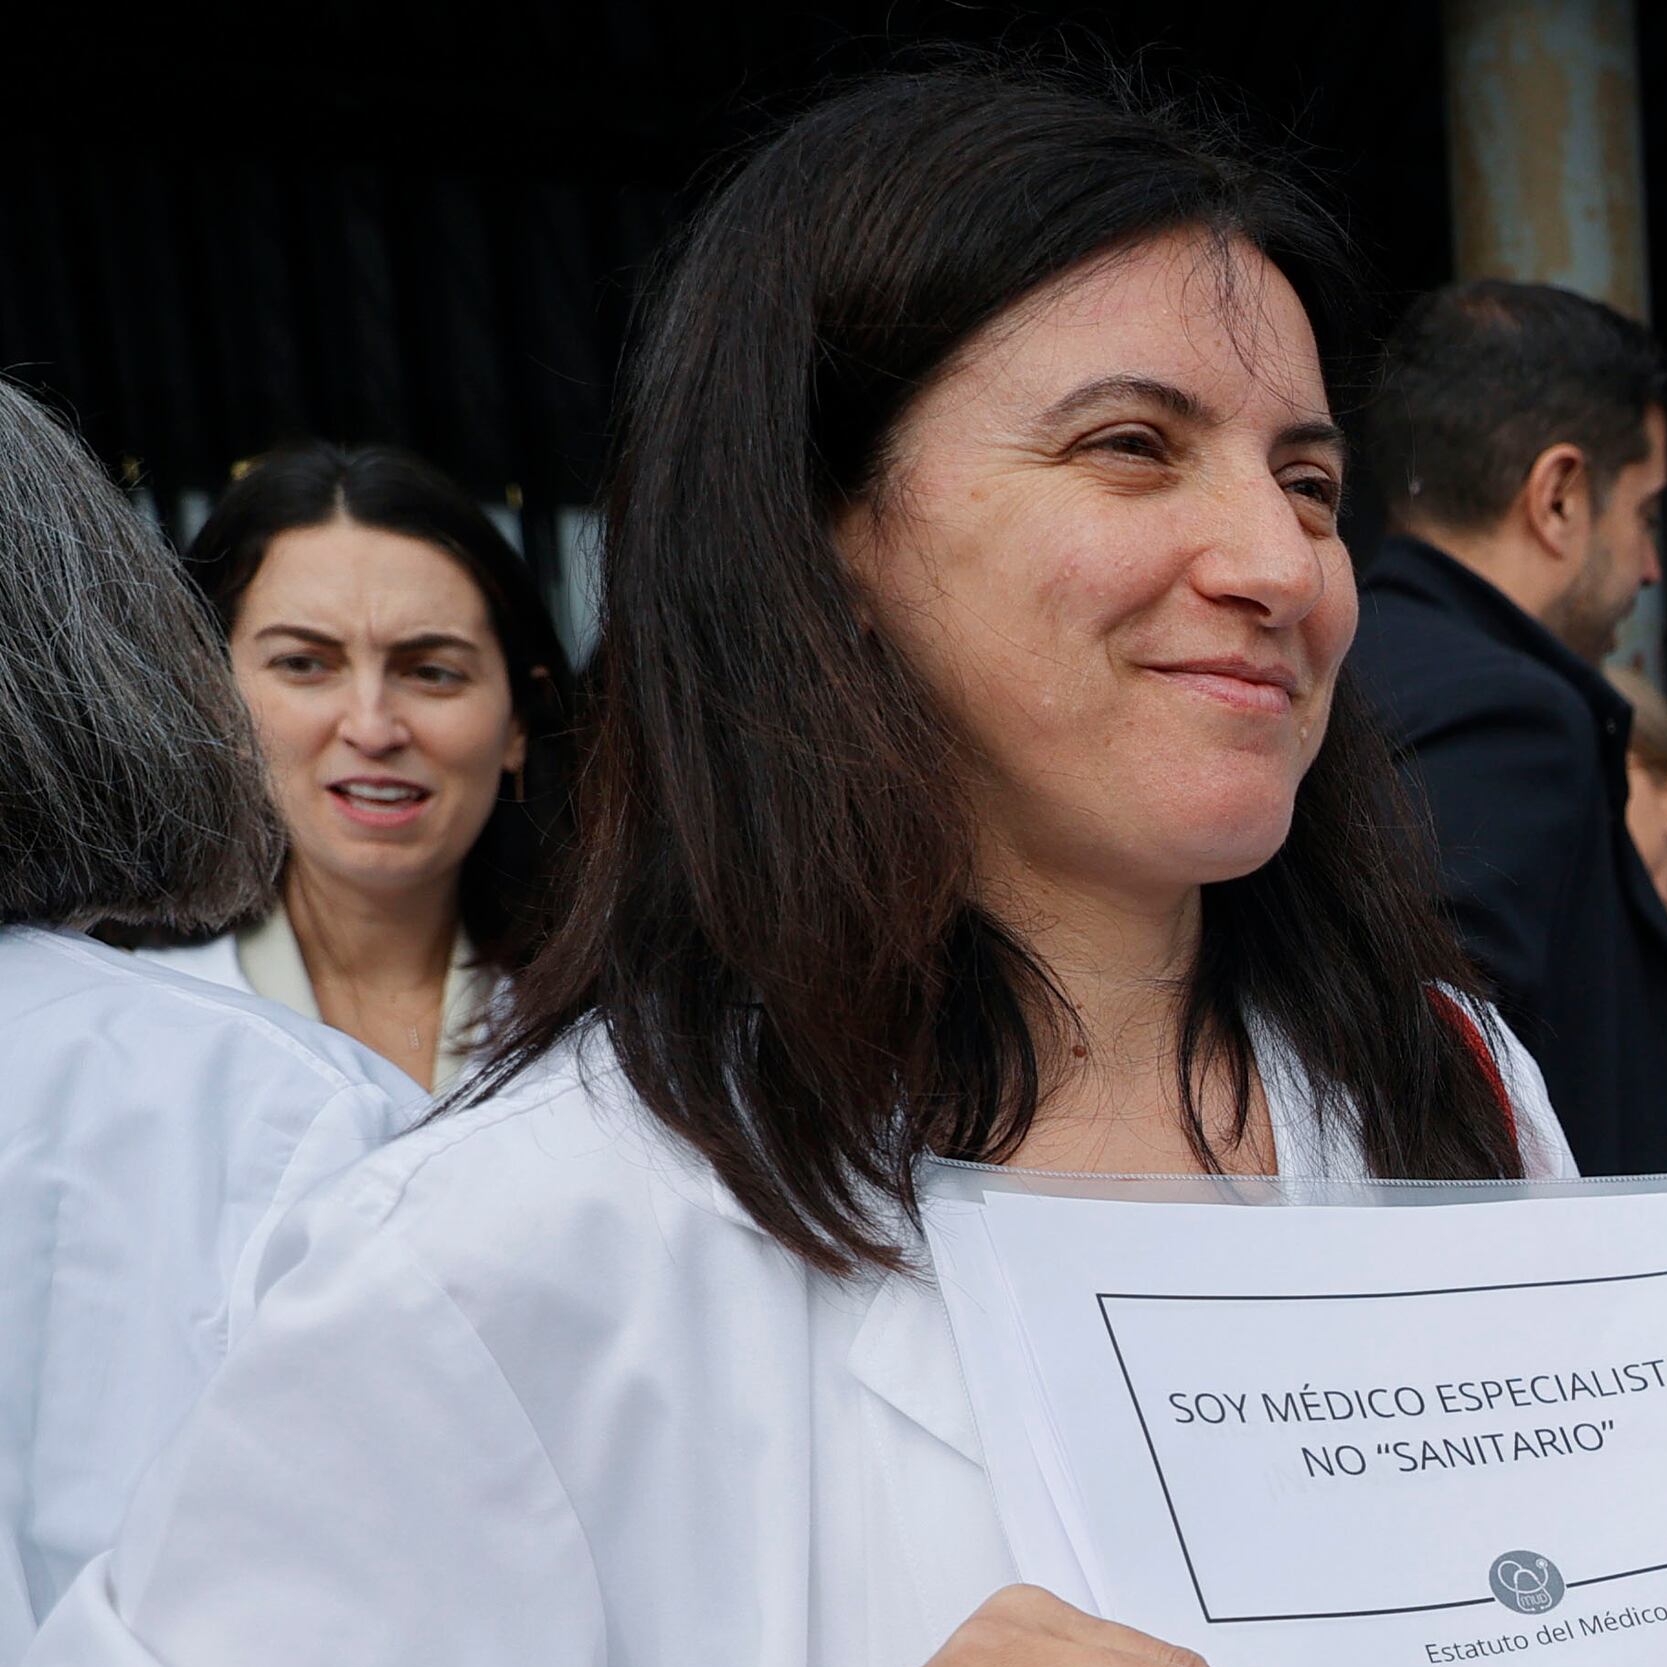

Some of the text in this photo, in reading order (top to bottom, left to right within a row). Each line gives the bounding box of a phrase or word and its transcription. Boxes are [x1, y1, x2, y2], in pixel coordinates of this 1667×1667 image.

[1169, 1391, 1247, 1424] SOY
[1261, 1383, 1426, 1423] MÉDICO
[1300, 1443, 1368, 1478] NO
[1424, 1632, 1530, 1664] Estatuto
[1535, 1620, 1575, 1647] del
